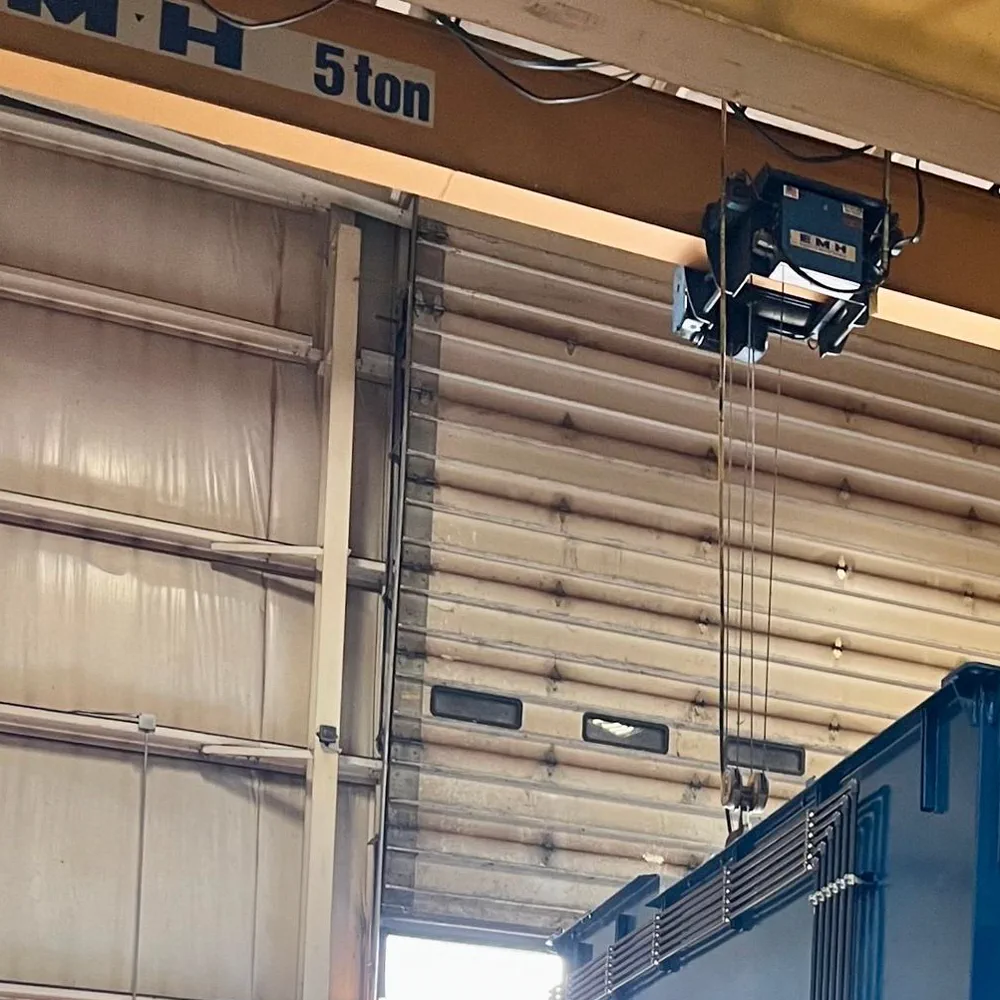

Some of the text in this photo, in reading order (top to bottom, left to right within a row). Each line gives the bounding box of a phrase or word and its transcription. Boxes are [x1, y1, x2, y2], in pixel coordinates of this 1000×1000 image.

[313, 42, 345, 97] 5
[353, 54, 431, 122] ton
[799, 233, 847, 254] EMH
